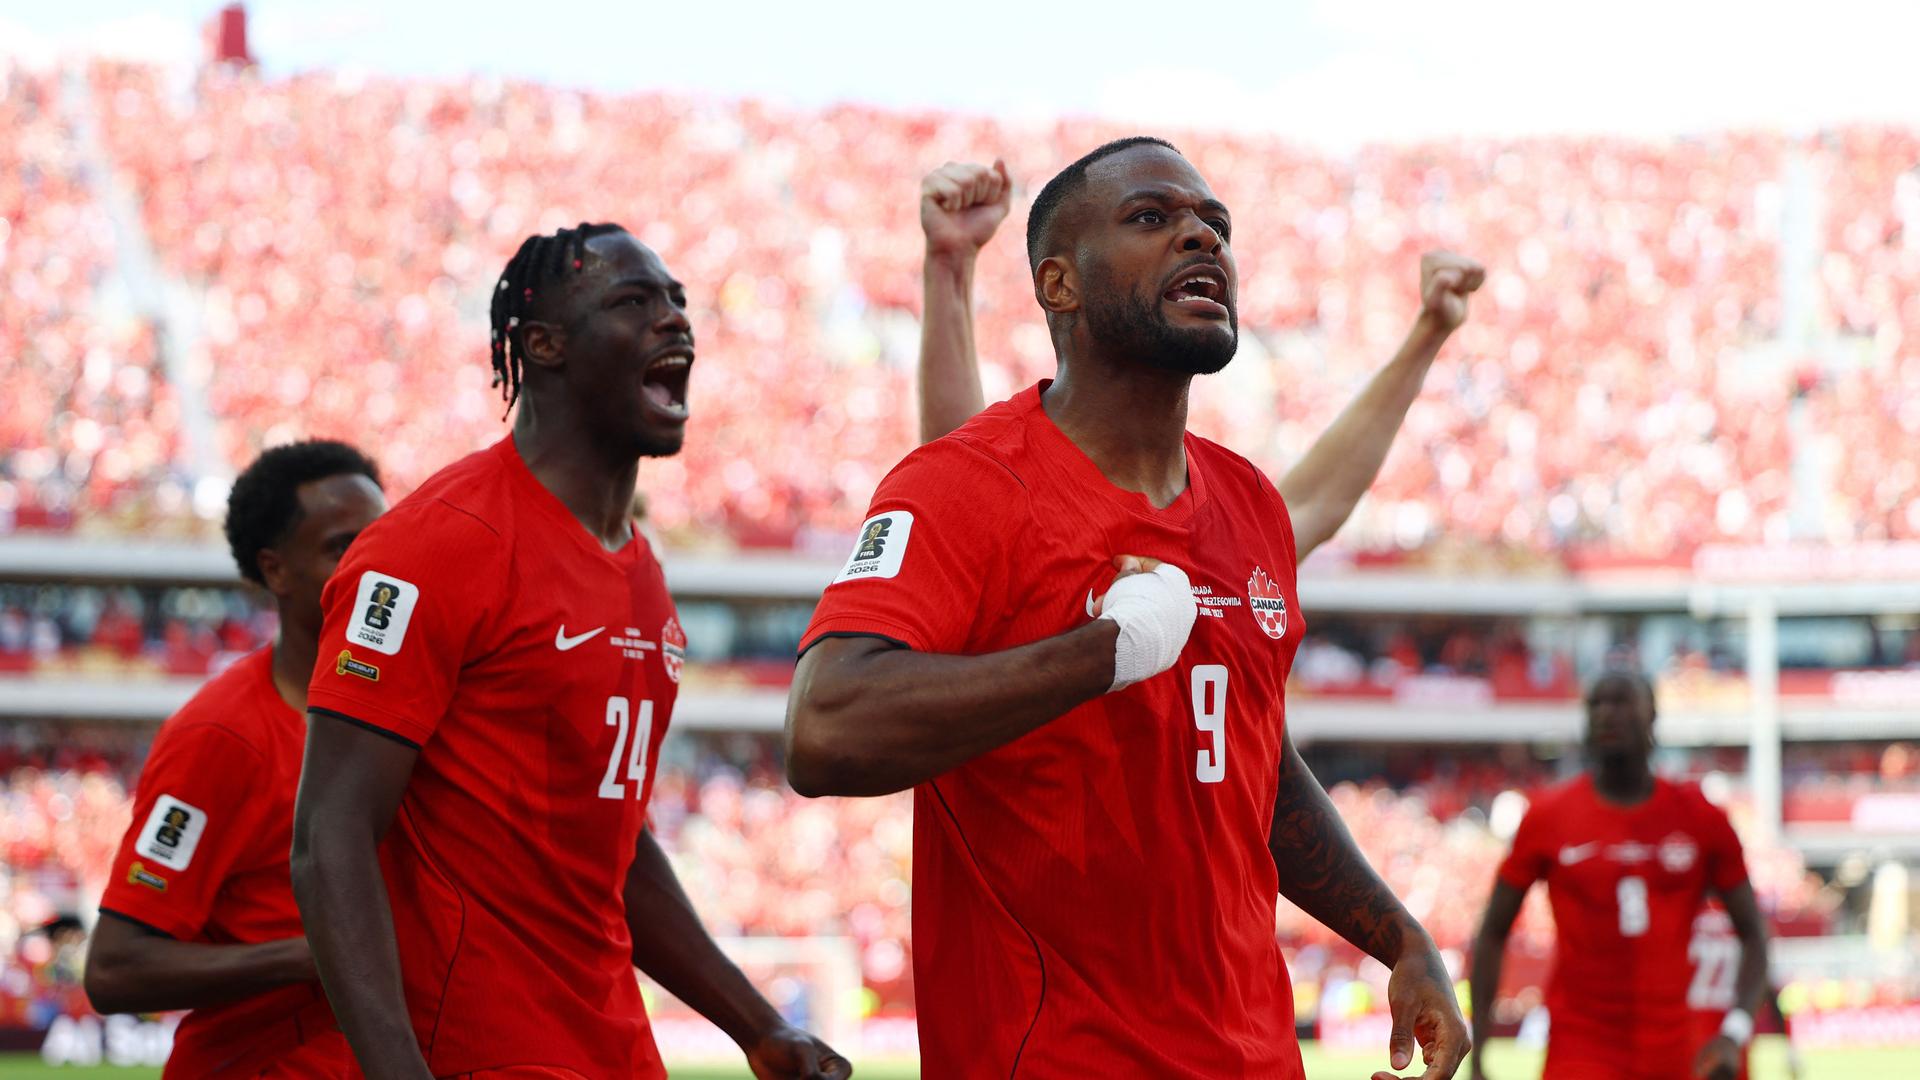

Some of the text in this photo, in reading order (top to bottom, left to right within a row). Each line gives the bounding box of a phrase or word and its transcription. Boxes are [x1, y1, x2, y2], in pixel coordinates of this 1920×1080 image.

[847, 565, 879, 575] 2026
[1250, 598, 1285, 611] CANADA
[357, 631, 384, 645] 2026
[348, 660, 376, 674] DEBUT
[1191, 664, 1228, 783] 9
[598, 696, 654, 800] 24
[1616, 876, 1649, 936] 8
